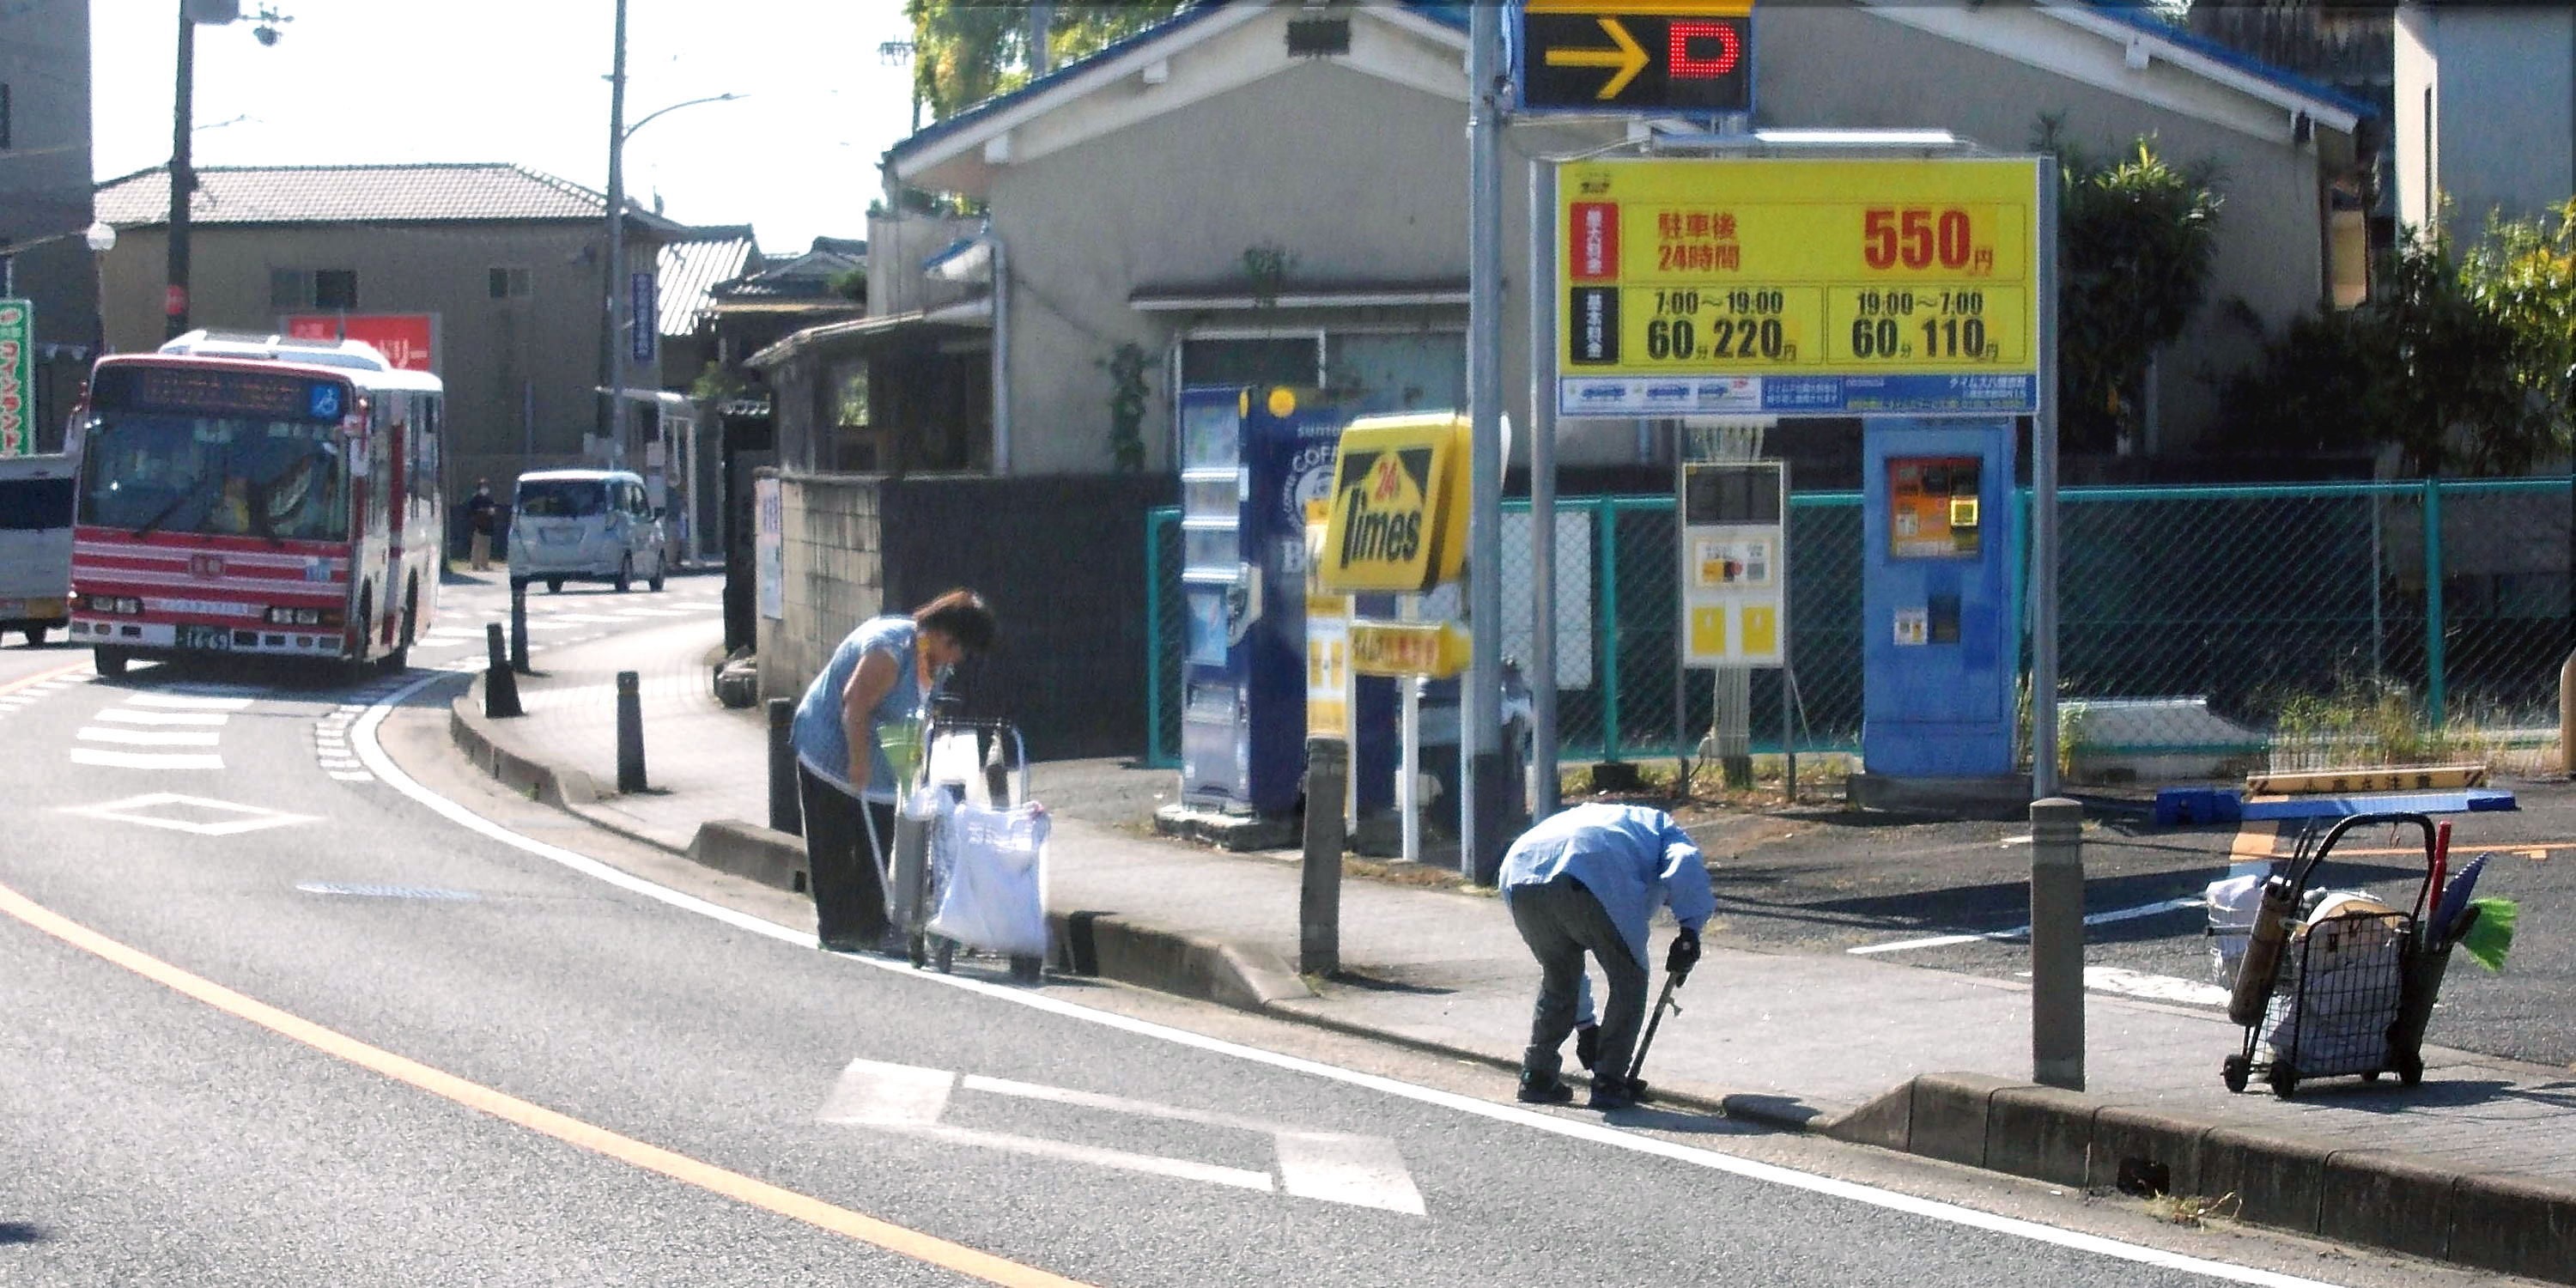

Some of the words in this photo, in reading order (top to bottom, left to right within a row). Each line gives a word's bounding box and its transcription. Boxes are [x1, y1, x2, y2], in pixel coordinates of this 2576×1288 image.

[1658, 212, 1736, 240] 駐車後
[1658, 244, 1740, 272] 24時間
